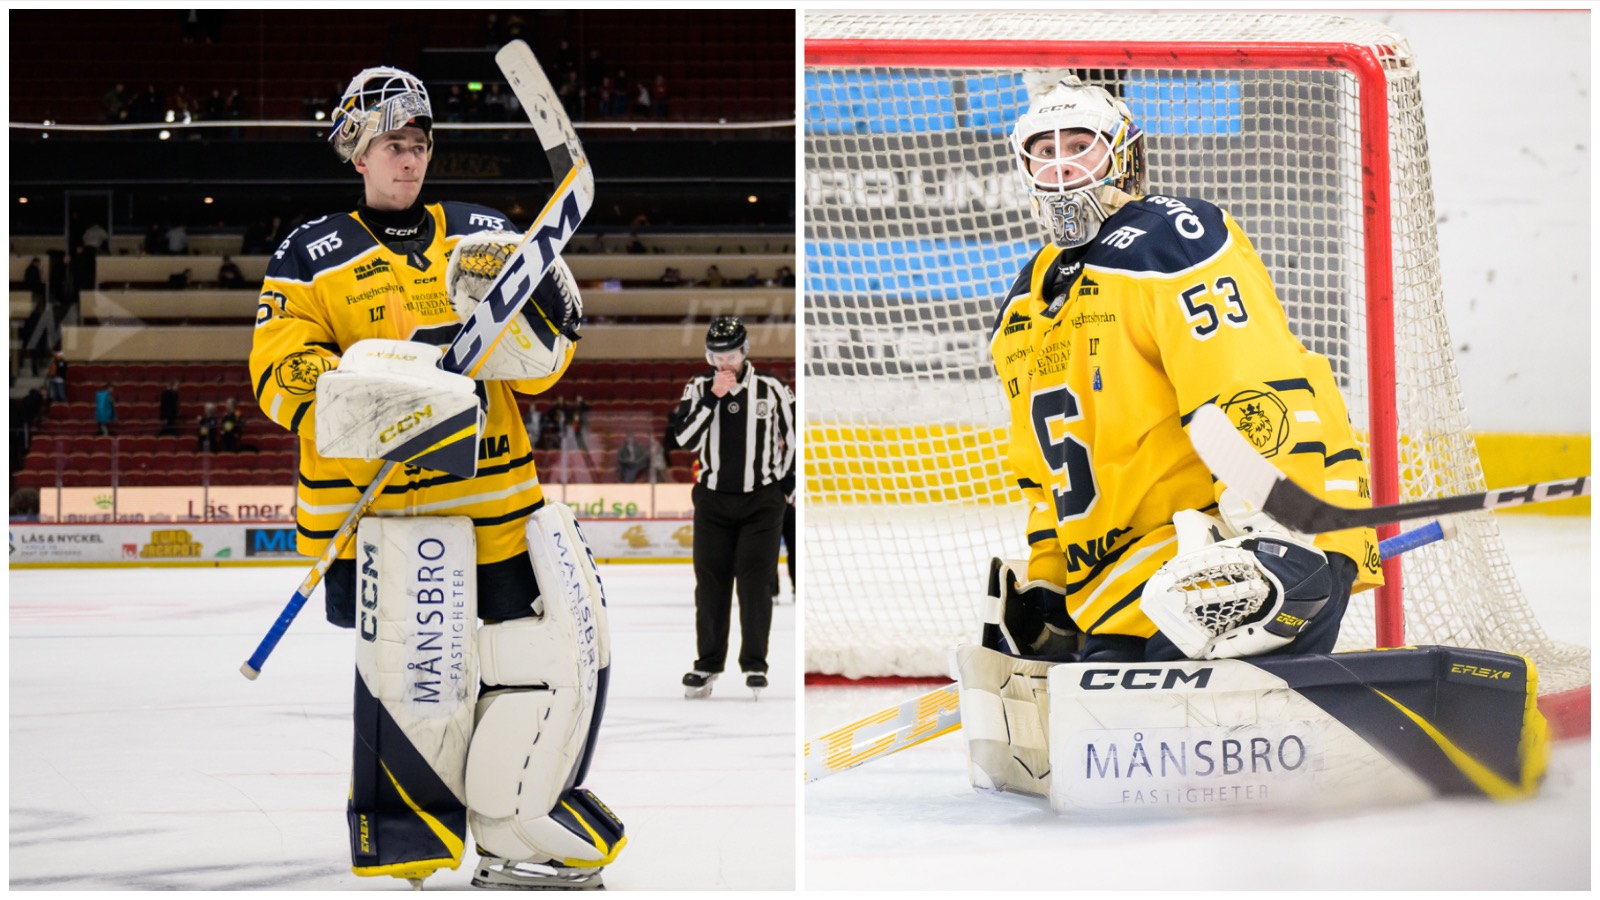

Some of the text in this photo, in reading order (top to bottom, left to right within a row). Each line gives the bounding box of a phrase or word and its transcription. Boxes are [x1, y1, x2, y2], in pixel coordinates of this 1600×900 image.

[1039, 103, 1077, 114] CCM
[384, 227, 419, 237] CCM
[469, 213, 505, 231] m3
[1050, 202, 1082, 242] 53
[306, 230, 343, 261] m3
[414, 276, 437, 285] CCM
[368, 305, 386, 322] LT
[1177, 275, 1248, 342] 53
[1089, 338, 1100, 356] LT
[379, 404, 433, 444] CCM
[238, 503, 284, 519] mer
[21, 533, 46, 543] LÅS
[57, 534, 104, 544] NYCKEL
[361, 541, 379, 643] CCM
[407, 538, 446, 703] MÅNSBRO
[450, 569, 465, 681] FASTIGHETER
[1080, 667, 1214, 690] CCM
[1086, 732, 1306, 779] MÅNSBRO
[1122, 784, 1270, 805] FASTIGHETER
